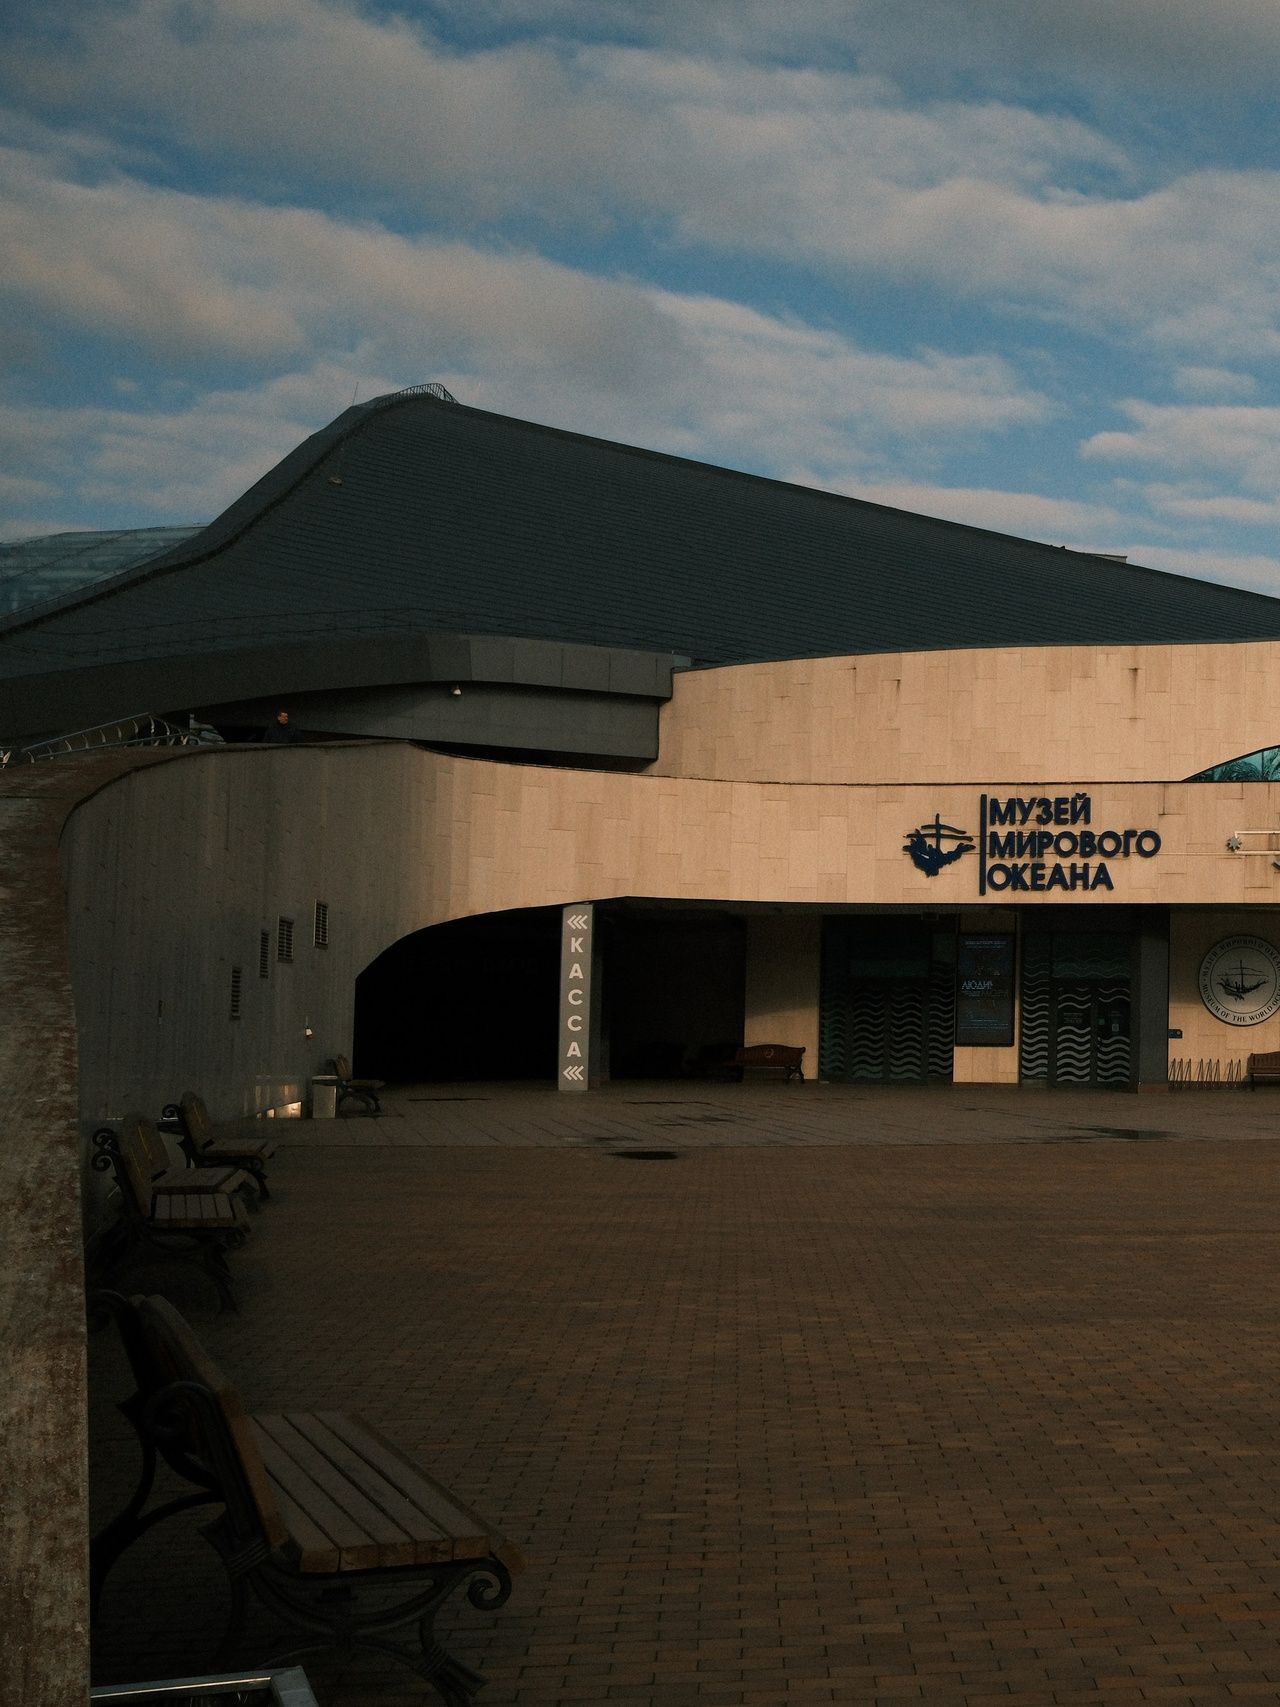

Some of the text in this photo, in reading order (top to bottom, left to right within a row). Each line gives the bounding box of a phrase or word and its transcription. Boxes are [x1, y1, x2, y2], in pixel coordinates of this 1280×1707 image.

[989, 792, 1092, 825] МУЗЕЙ
[989, 830, 1162, 858] МИРОВОГО
[987, 862, 1114, 891] ОКЕАНА
[566, 937, 584, 1058] КАССА
[1202, 983, 1221, 1013] MUSEUM
[1220, 1010, 1231, 1019] OF
[1232, 1014, 1247, 1022] THE
[1248, 1005, 1274, 1021] WORLD
